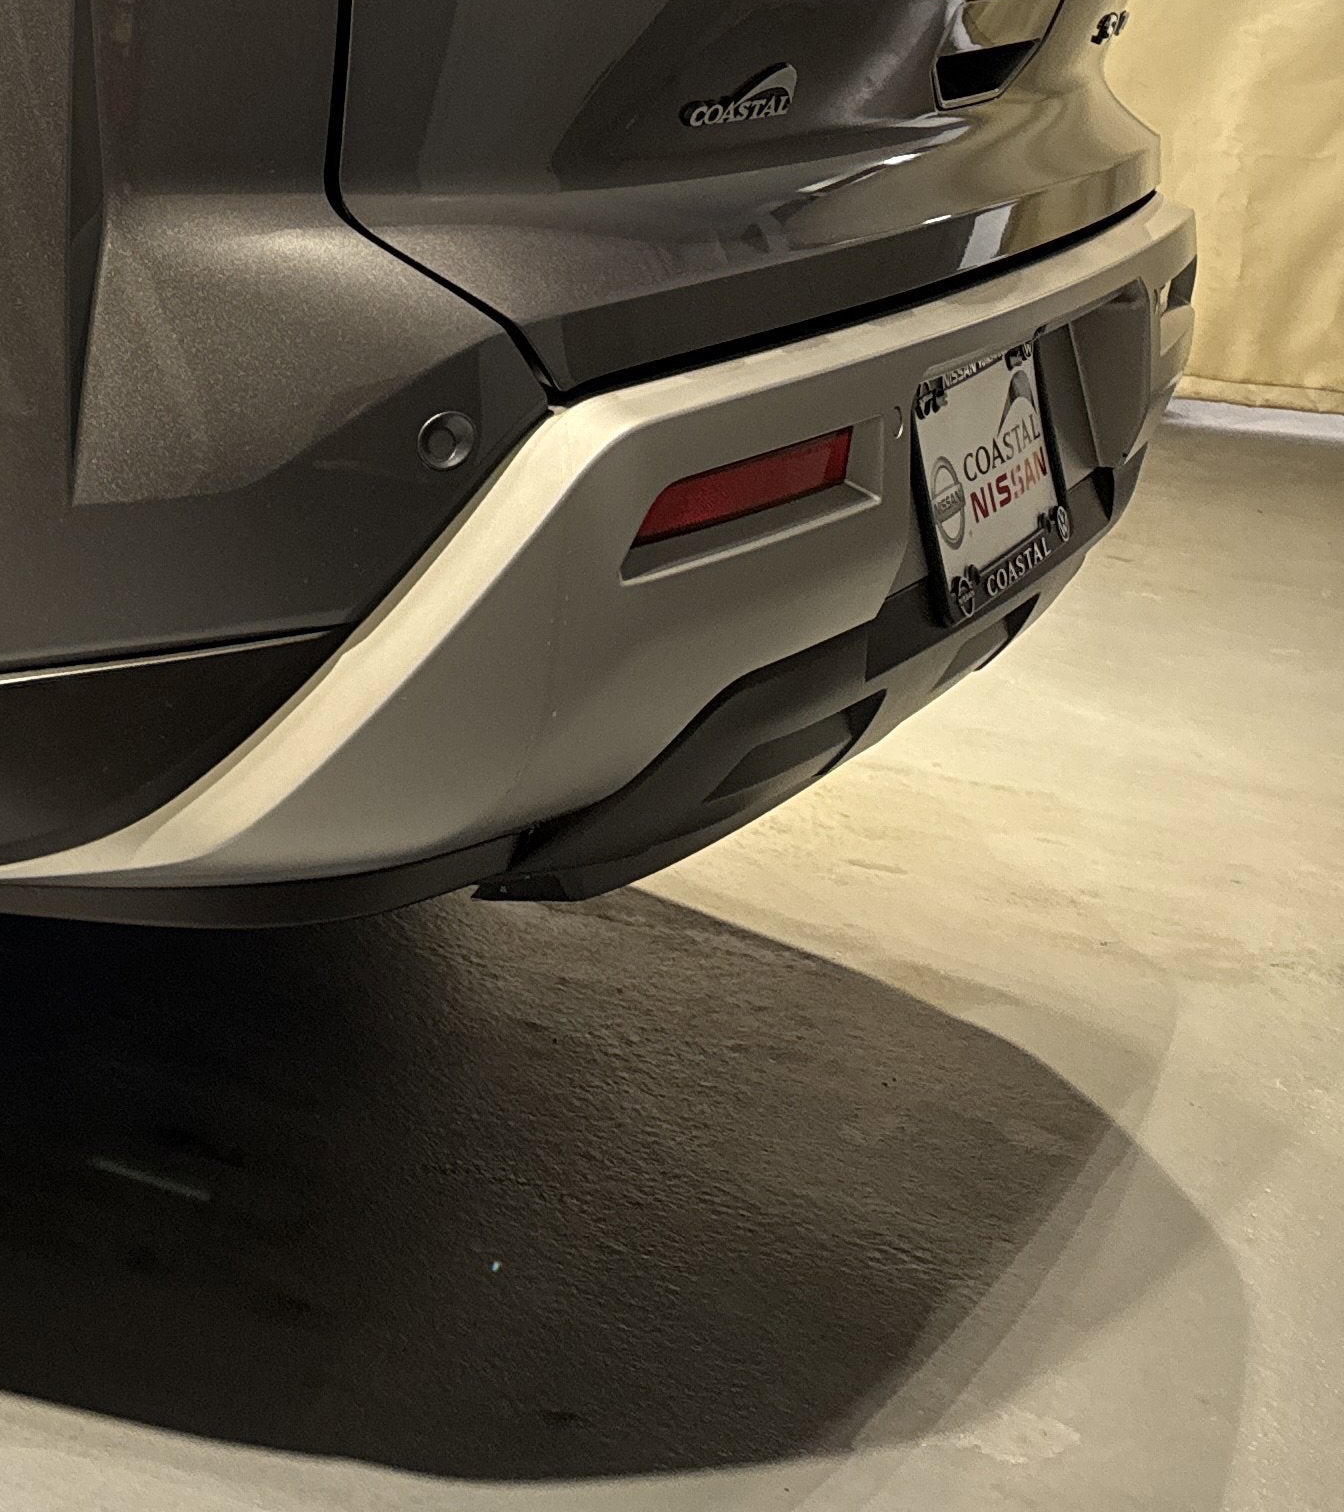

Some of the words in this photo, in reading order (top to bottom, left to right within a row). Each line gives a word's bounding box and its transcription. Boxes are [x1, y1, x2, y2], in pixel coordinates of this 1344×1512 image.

[689, 95, 790, 127] COASTAL
[963, 413, 1041, 482] COASTAL
[969, 446, 1048, 524] NISSAN
[986, 536, 1052, 597] COASTAL
